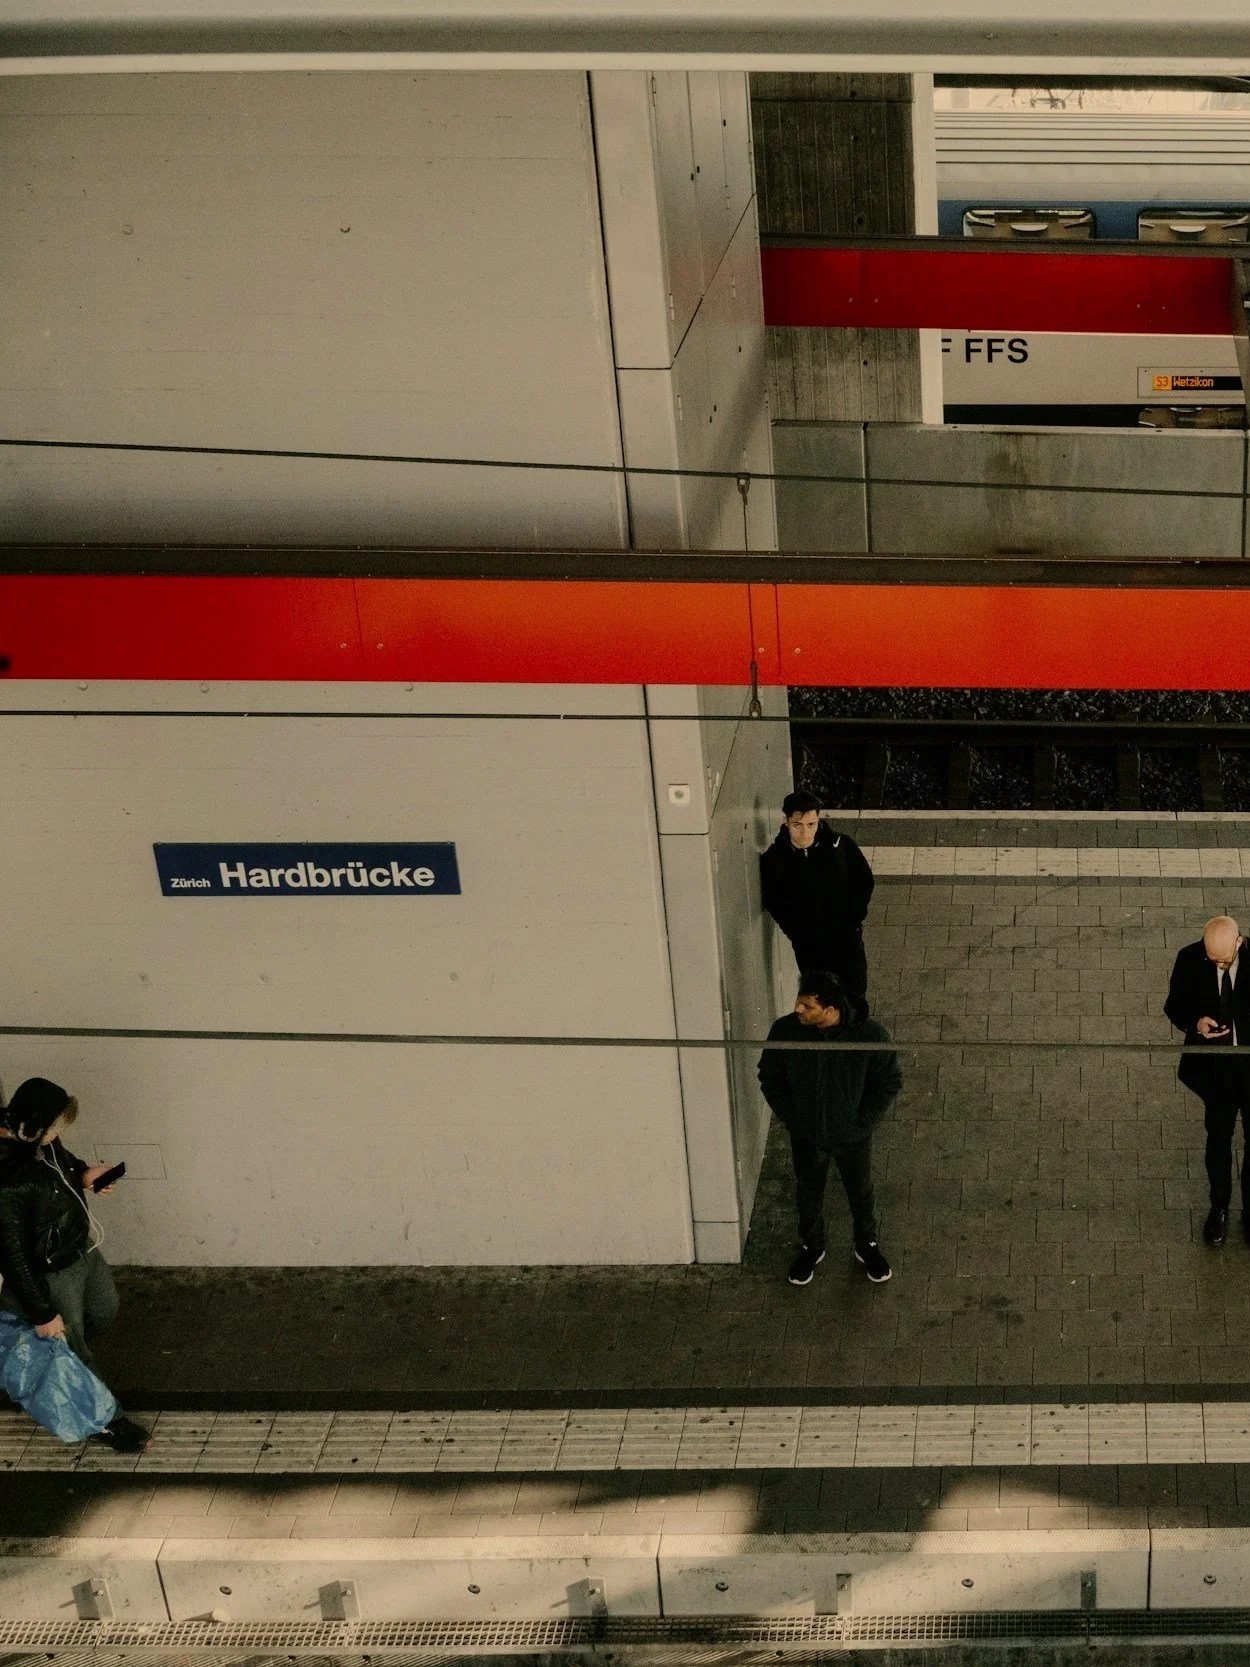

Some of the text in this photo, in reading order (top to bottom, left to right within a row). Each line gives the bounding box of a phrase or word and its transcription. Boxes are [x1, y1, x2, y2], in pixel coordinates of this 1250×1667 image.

[965, 338, 1028, 363] FFS
[1156, 376, 1214, 388] S3 Wetzikon
[171, 861, 435, 888] Zürich Hardbrücke
